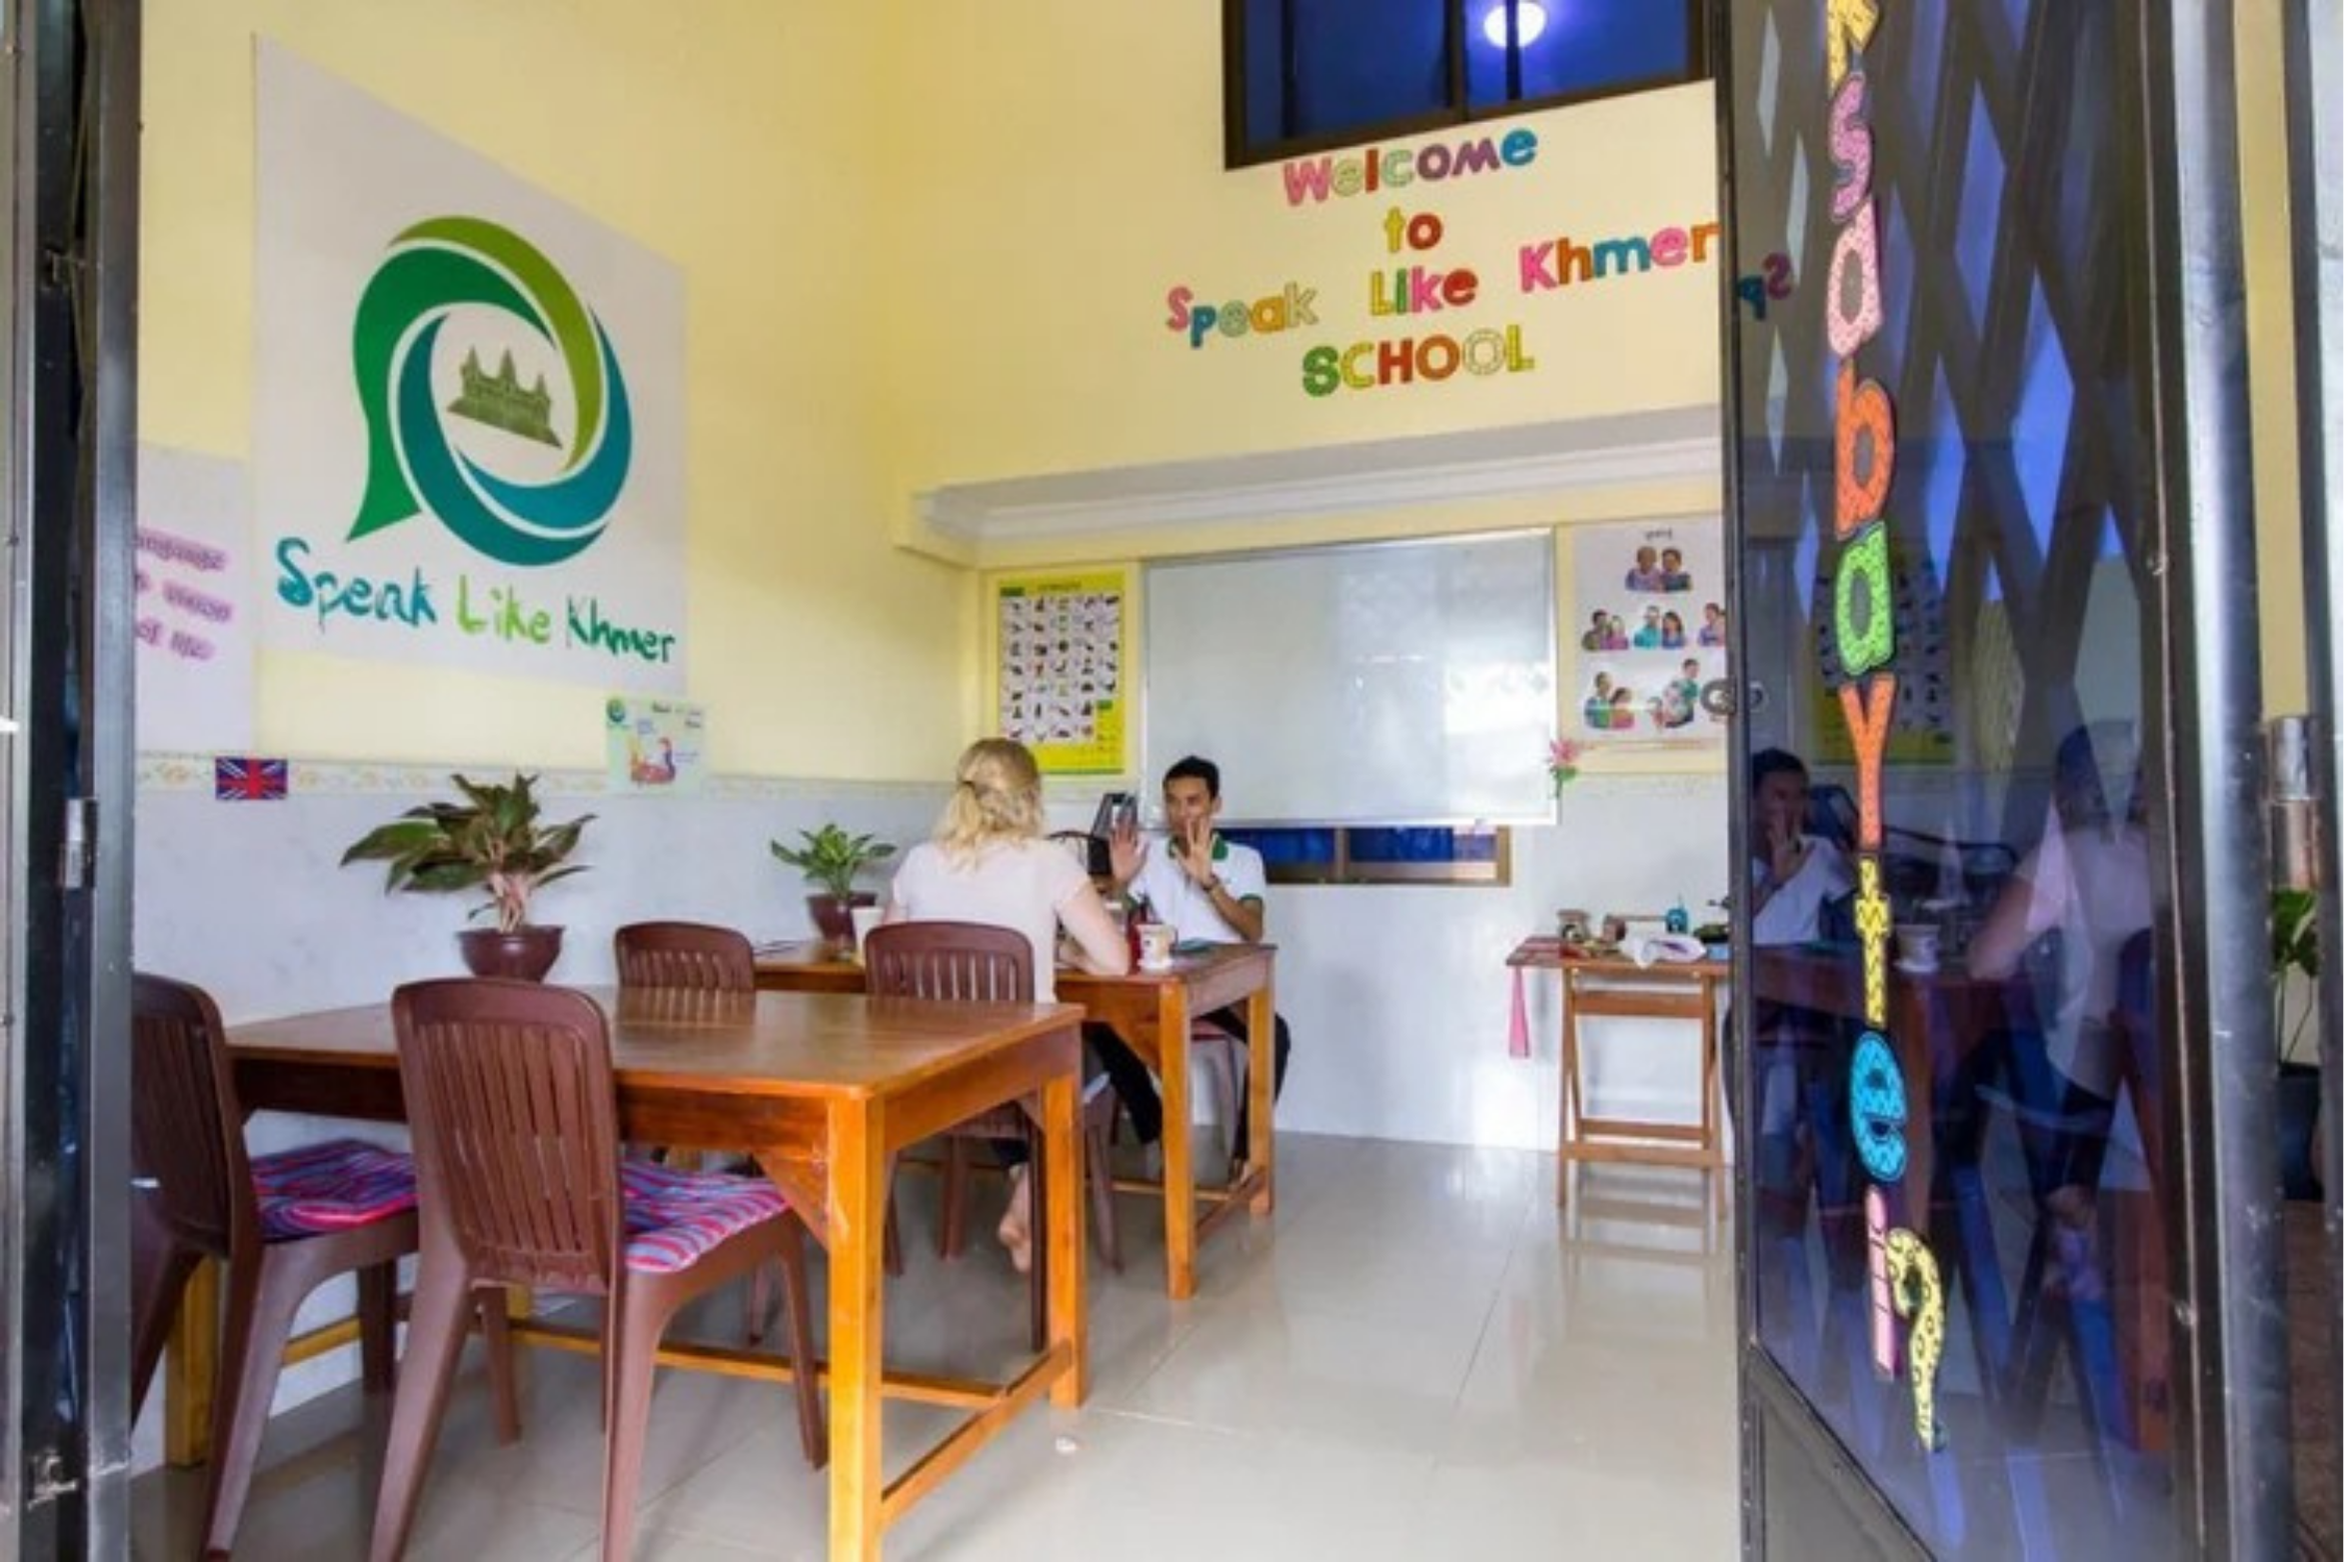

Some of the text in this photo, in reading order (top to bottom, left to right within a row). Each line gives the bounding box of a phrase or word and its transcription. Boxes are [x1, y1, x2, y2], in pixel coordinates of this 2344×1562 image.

[1284, 128, 1539, 207] Welcome
[1384, 206, 1443, 253] to
[1165, 223, 1722, 349] Speak Like Khmer
[1303, 325, 1535, 397] SCHOOL
[277, 537, 677, 664] Speak Like Khmer
